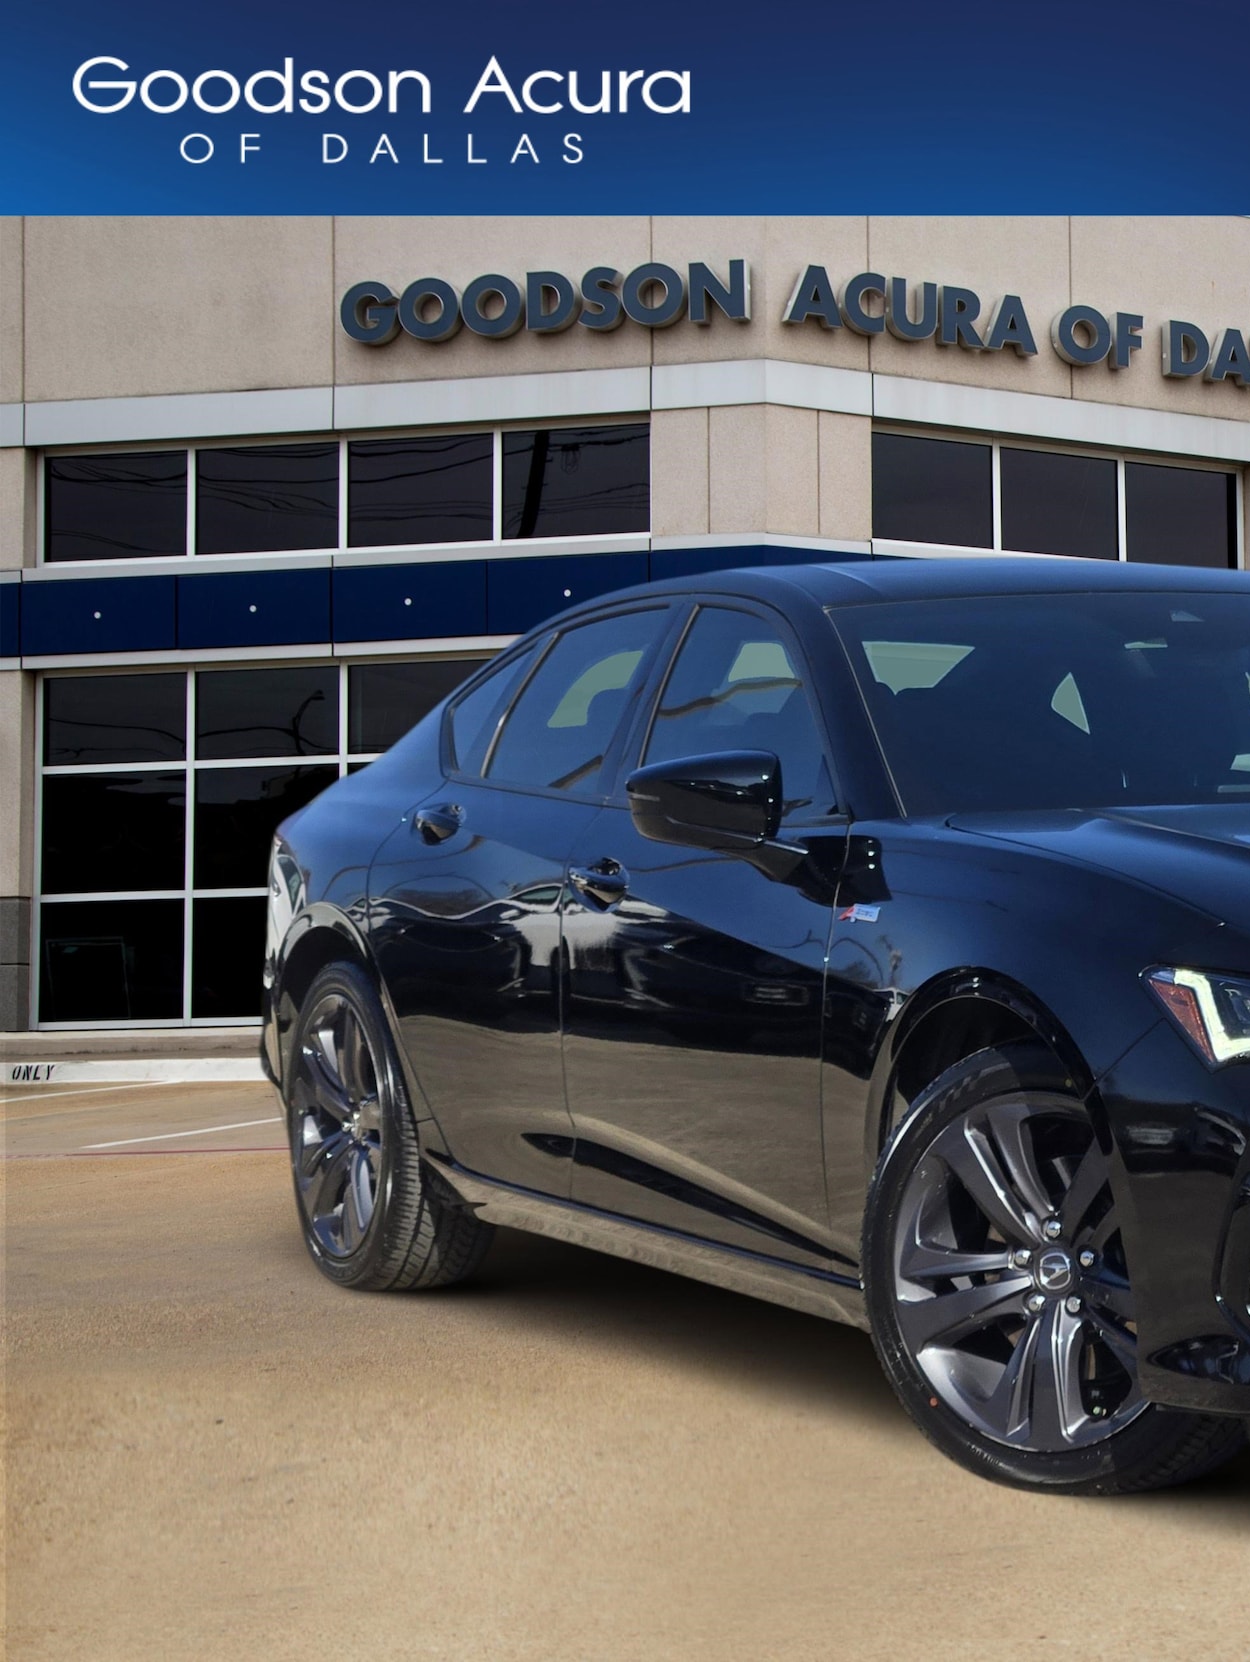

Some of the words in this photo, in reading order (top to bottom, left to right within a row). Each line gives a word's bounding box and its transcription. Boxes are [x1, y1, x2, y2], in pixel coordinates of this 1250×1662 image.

[340, 259, 751, 347] GOODSON
[782, 264, 1038, 357] ACURA
[1051, 304, 1144, 370] OF
[12, 1064, 55, 1081] ONLY
